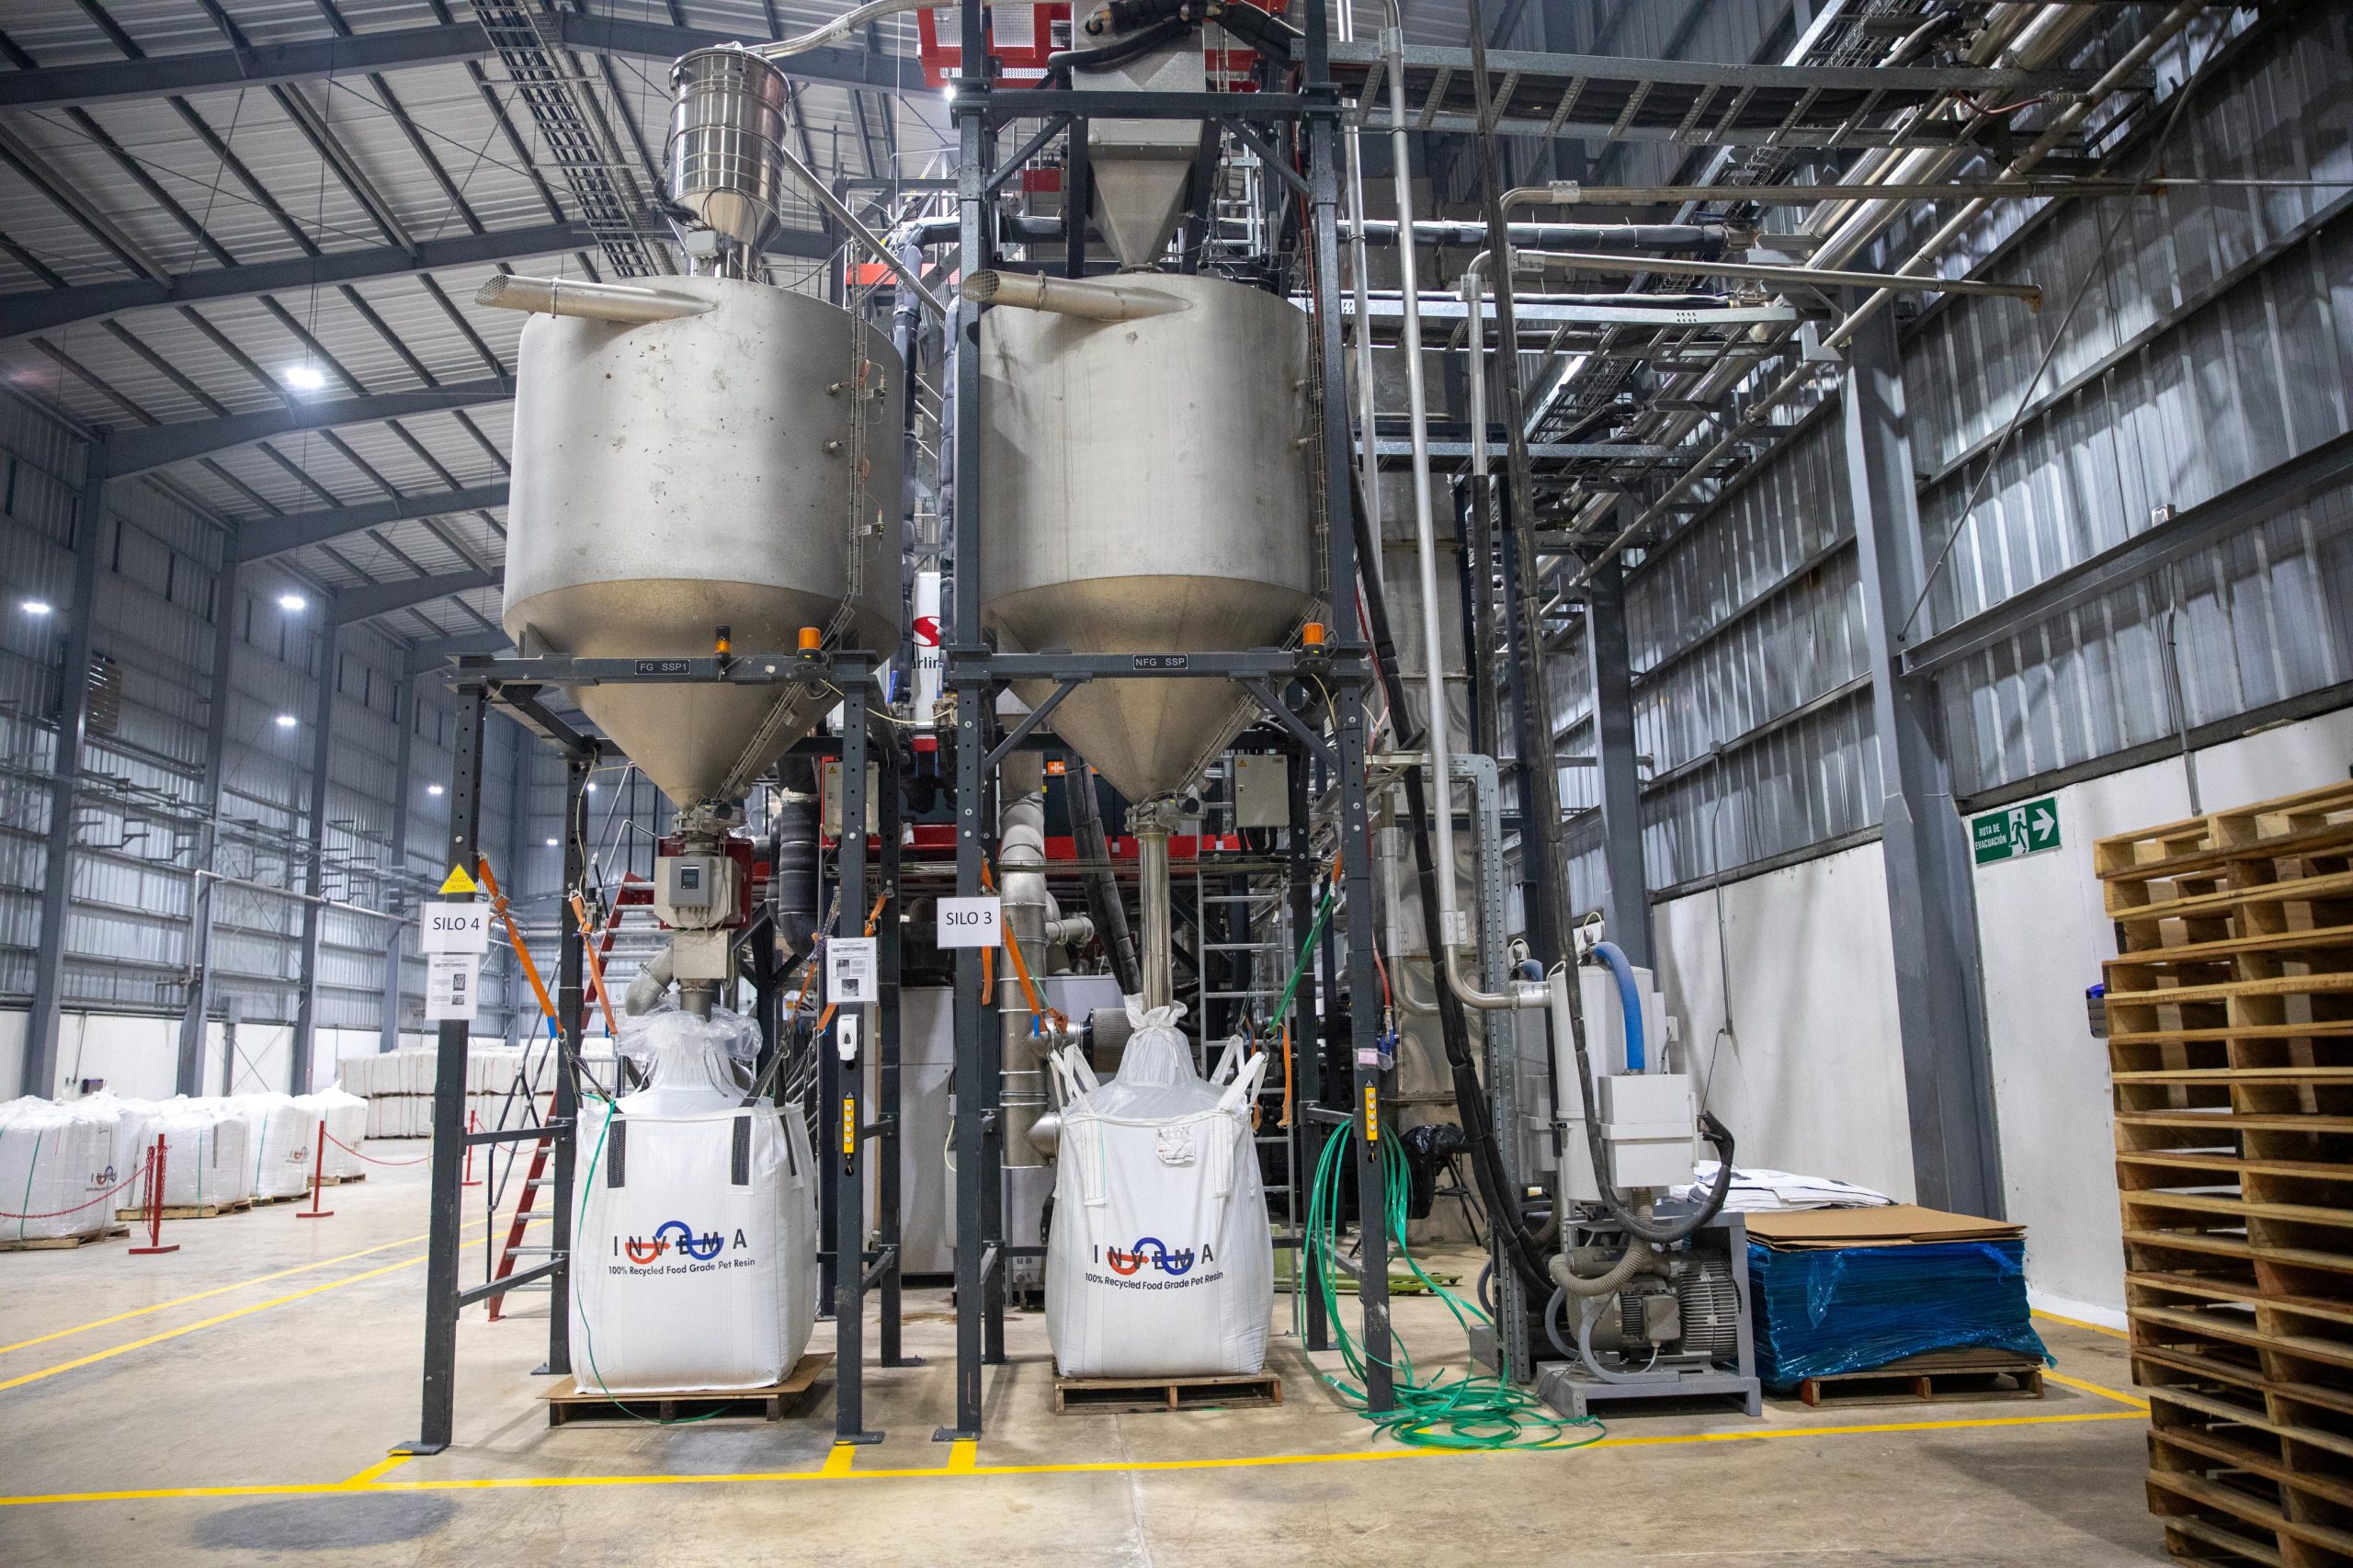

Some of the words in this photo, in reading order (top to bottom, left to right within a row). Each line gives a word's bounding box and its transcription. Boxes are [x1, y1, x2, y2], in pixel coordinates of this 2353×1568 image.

[640, 663, 654, 671] FG
[662, 663, 687, 671] SSP1
[1135, 658, 1157, 666] NFG
[1165, 657, 1185, 666] SSP
[1979, 825, 1993, 837] RUTA
[1993, 824, 2000, 833] DE
[1975, 834, 2007, 850] EVACUACIÓN
[433, 917, 466, 930] SILO
[471, 917, 480, 930] 4
[946, 912, 979, 926] SILO
[983, 911, 992, 925] 3
[608, 1266, 628, 1275] 100%
[629, 1266, 665, 1277] Recycled
[666, 1265, 687, 1274] Food
[689, 1263, 716, 1273] Grade
[718, 1260, 732, 1269] Pet
[733, 1257, 756, 1267] Resin
[1086, 1272, 1104, 1284] 100%
[1105, 1277, 1141, 1290] Recycled
[1142, 1281, 1163, 1290] Food
[1164, 1278, 1189, 1289] Grade
[1190, 1277, 1204, 1286] Pet
[1204, 1270, 1223, 1283] Resin
